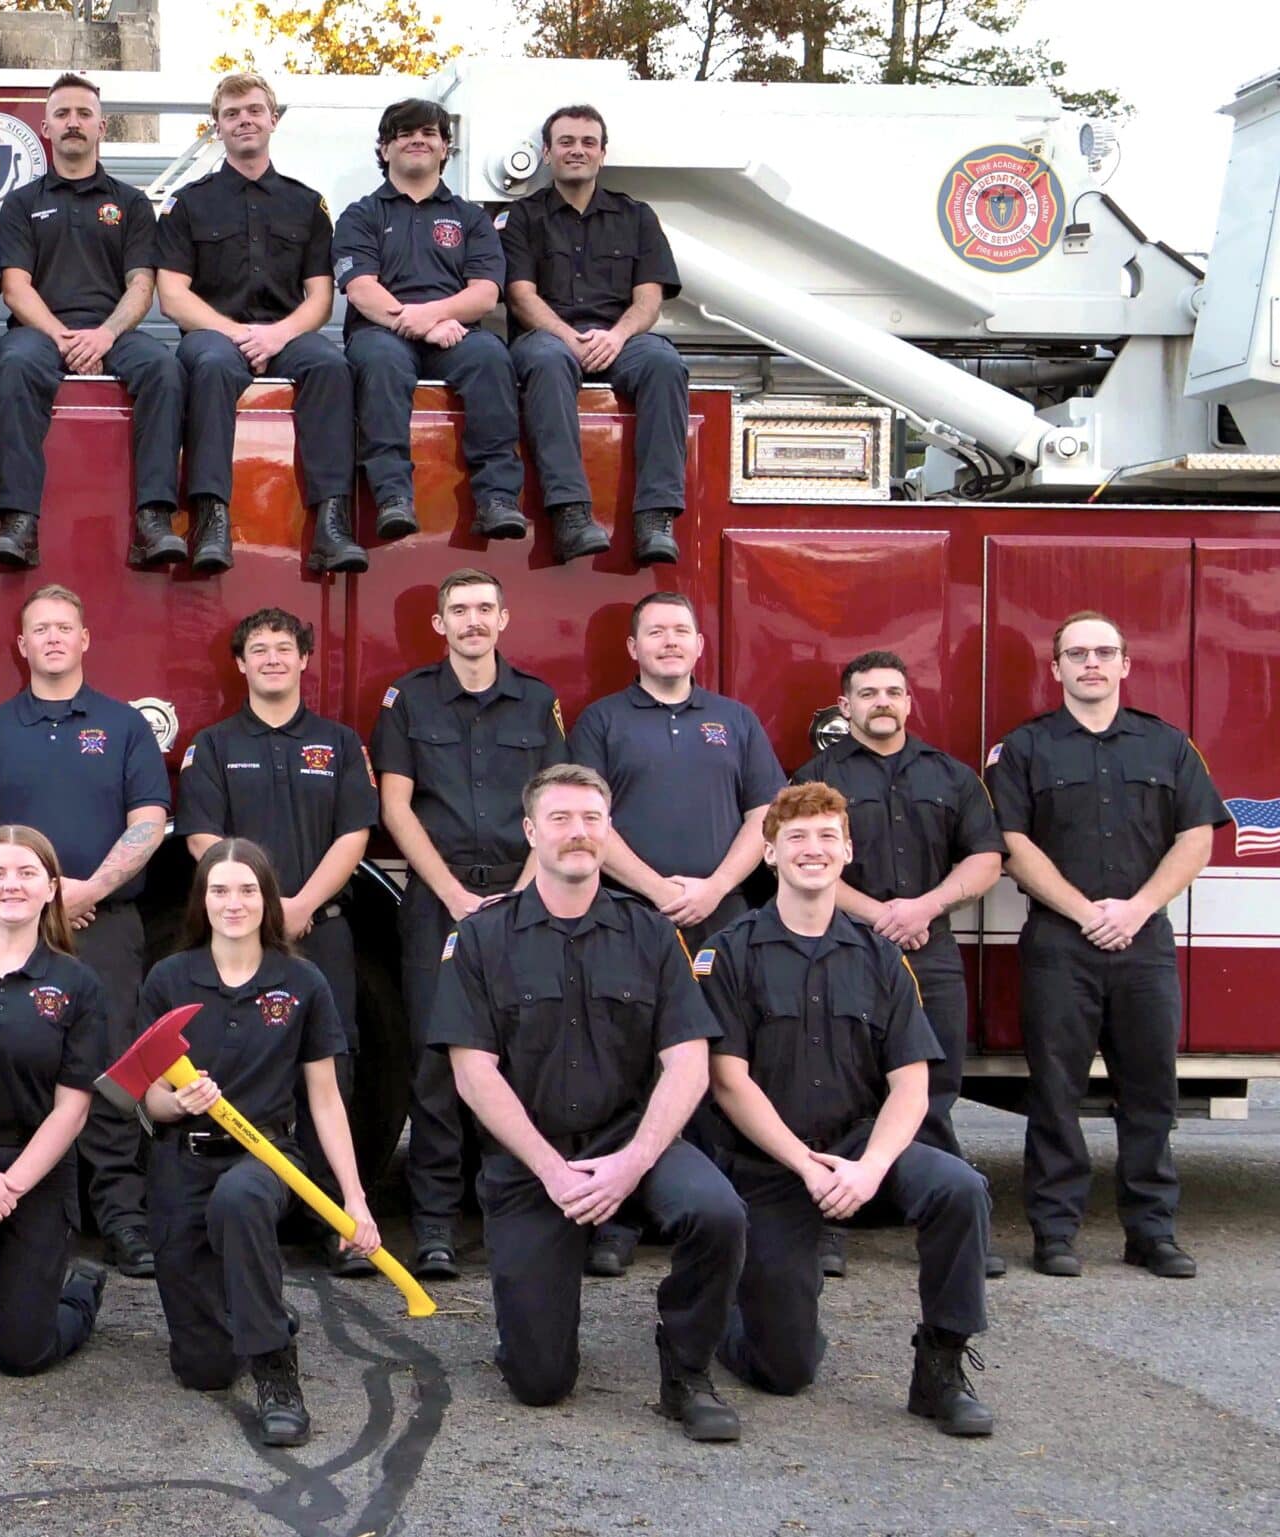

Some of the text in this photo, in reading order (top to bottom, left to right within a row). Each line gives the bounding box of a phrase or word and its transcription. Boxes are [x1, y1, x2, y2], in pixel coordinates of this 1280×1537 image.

[6, 120, 41, 166] SIGILLUM
[975, 160, 1029, 174] FIRE ACADEMY
[953, 181, 969, 237] ADMINISTRATION
[978, 173, 1033, 200] DEPARTMENT
[1028, 201, 1037, 217] OF
[1040, 194, 1050, 225] HAZMAT
[971, 222, 1032, 245] FIRE SERVICES
[975, 244, 1027, 258] FIRE MARSHAL
